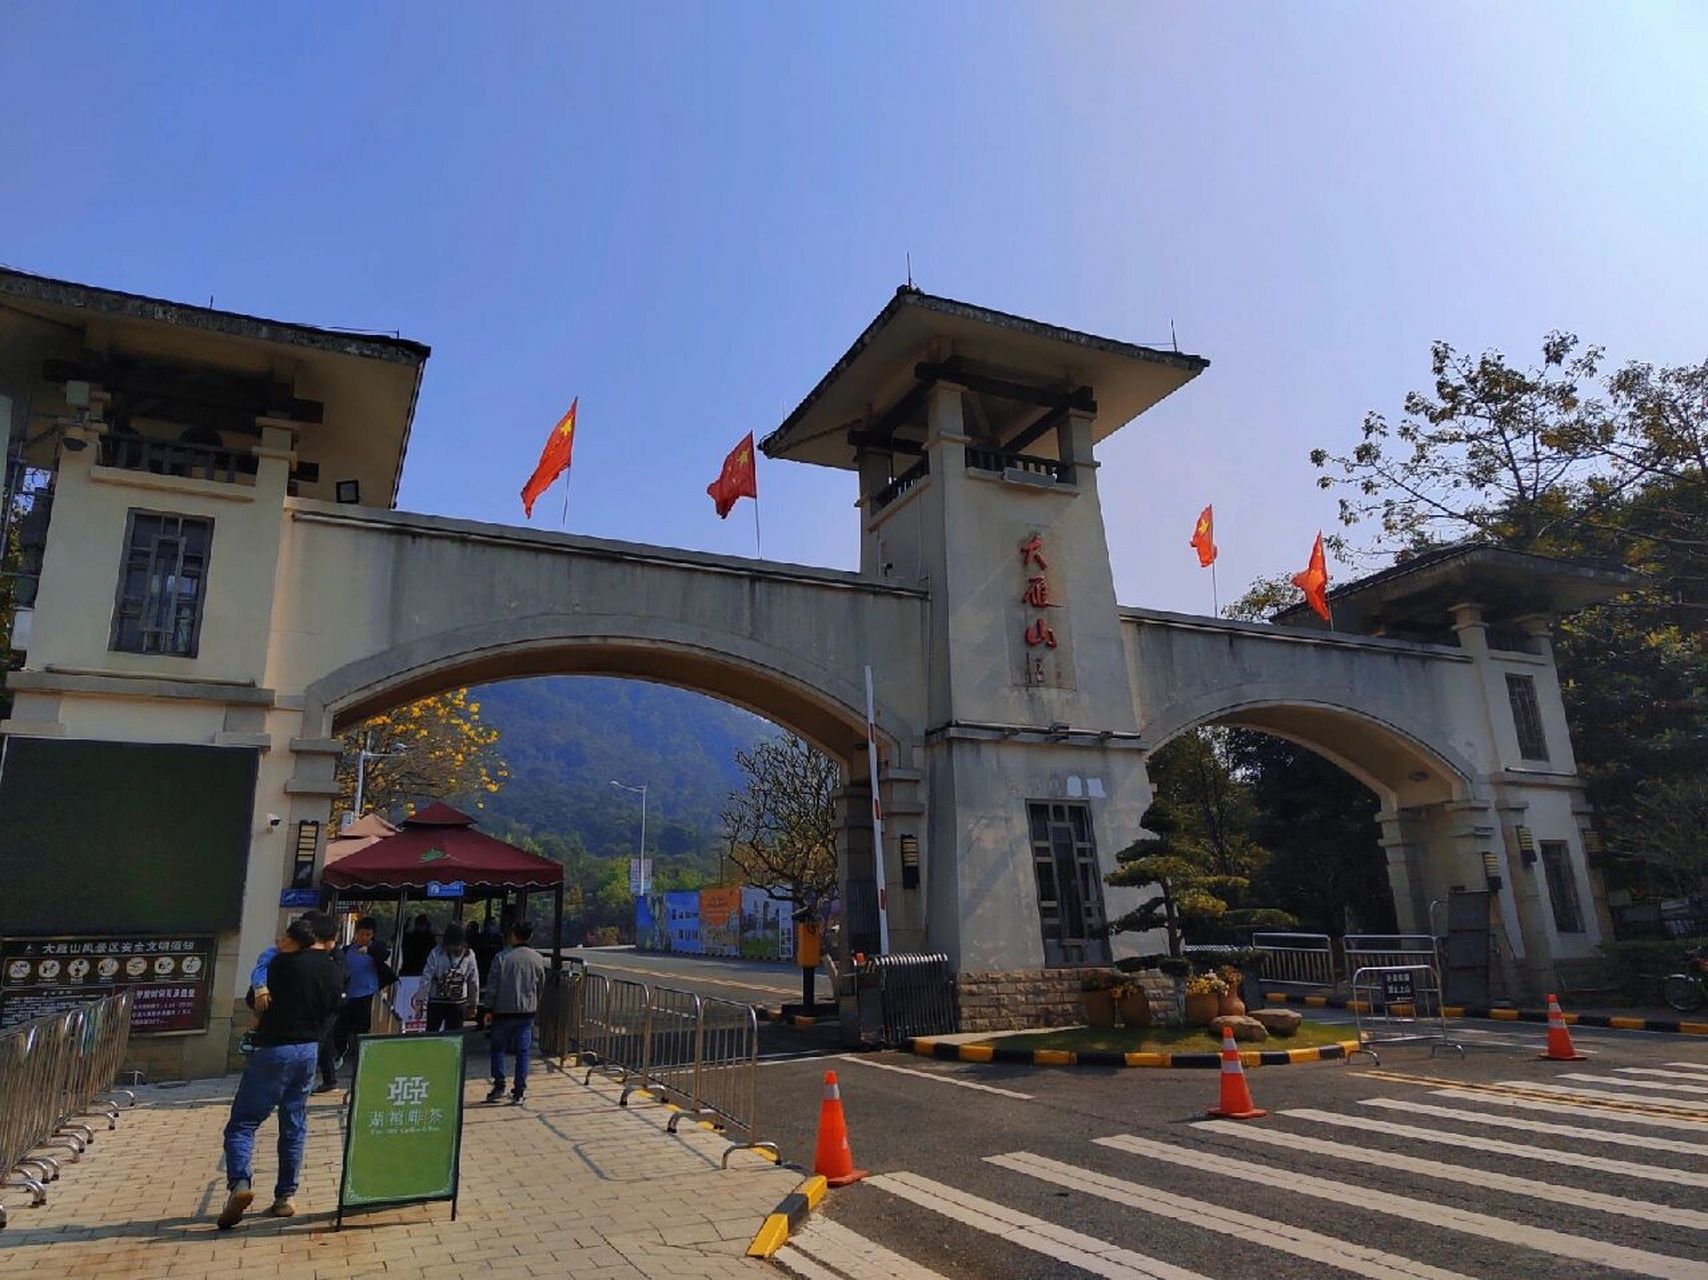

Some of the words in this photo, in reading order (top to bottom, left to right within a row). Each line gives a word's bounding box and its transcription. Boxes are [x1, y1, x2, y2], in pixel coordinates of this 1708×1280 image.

[1021, 533, 1064, 650] 大雁山
[42, 941, 194, 954] 大雁山风景区安全文明须知
